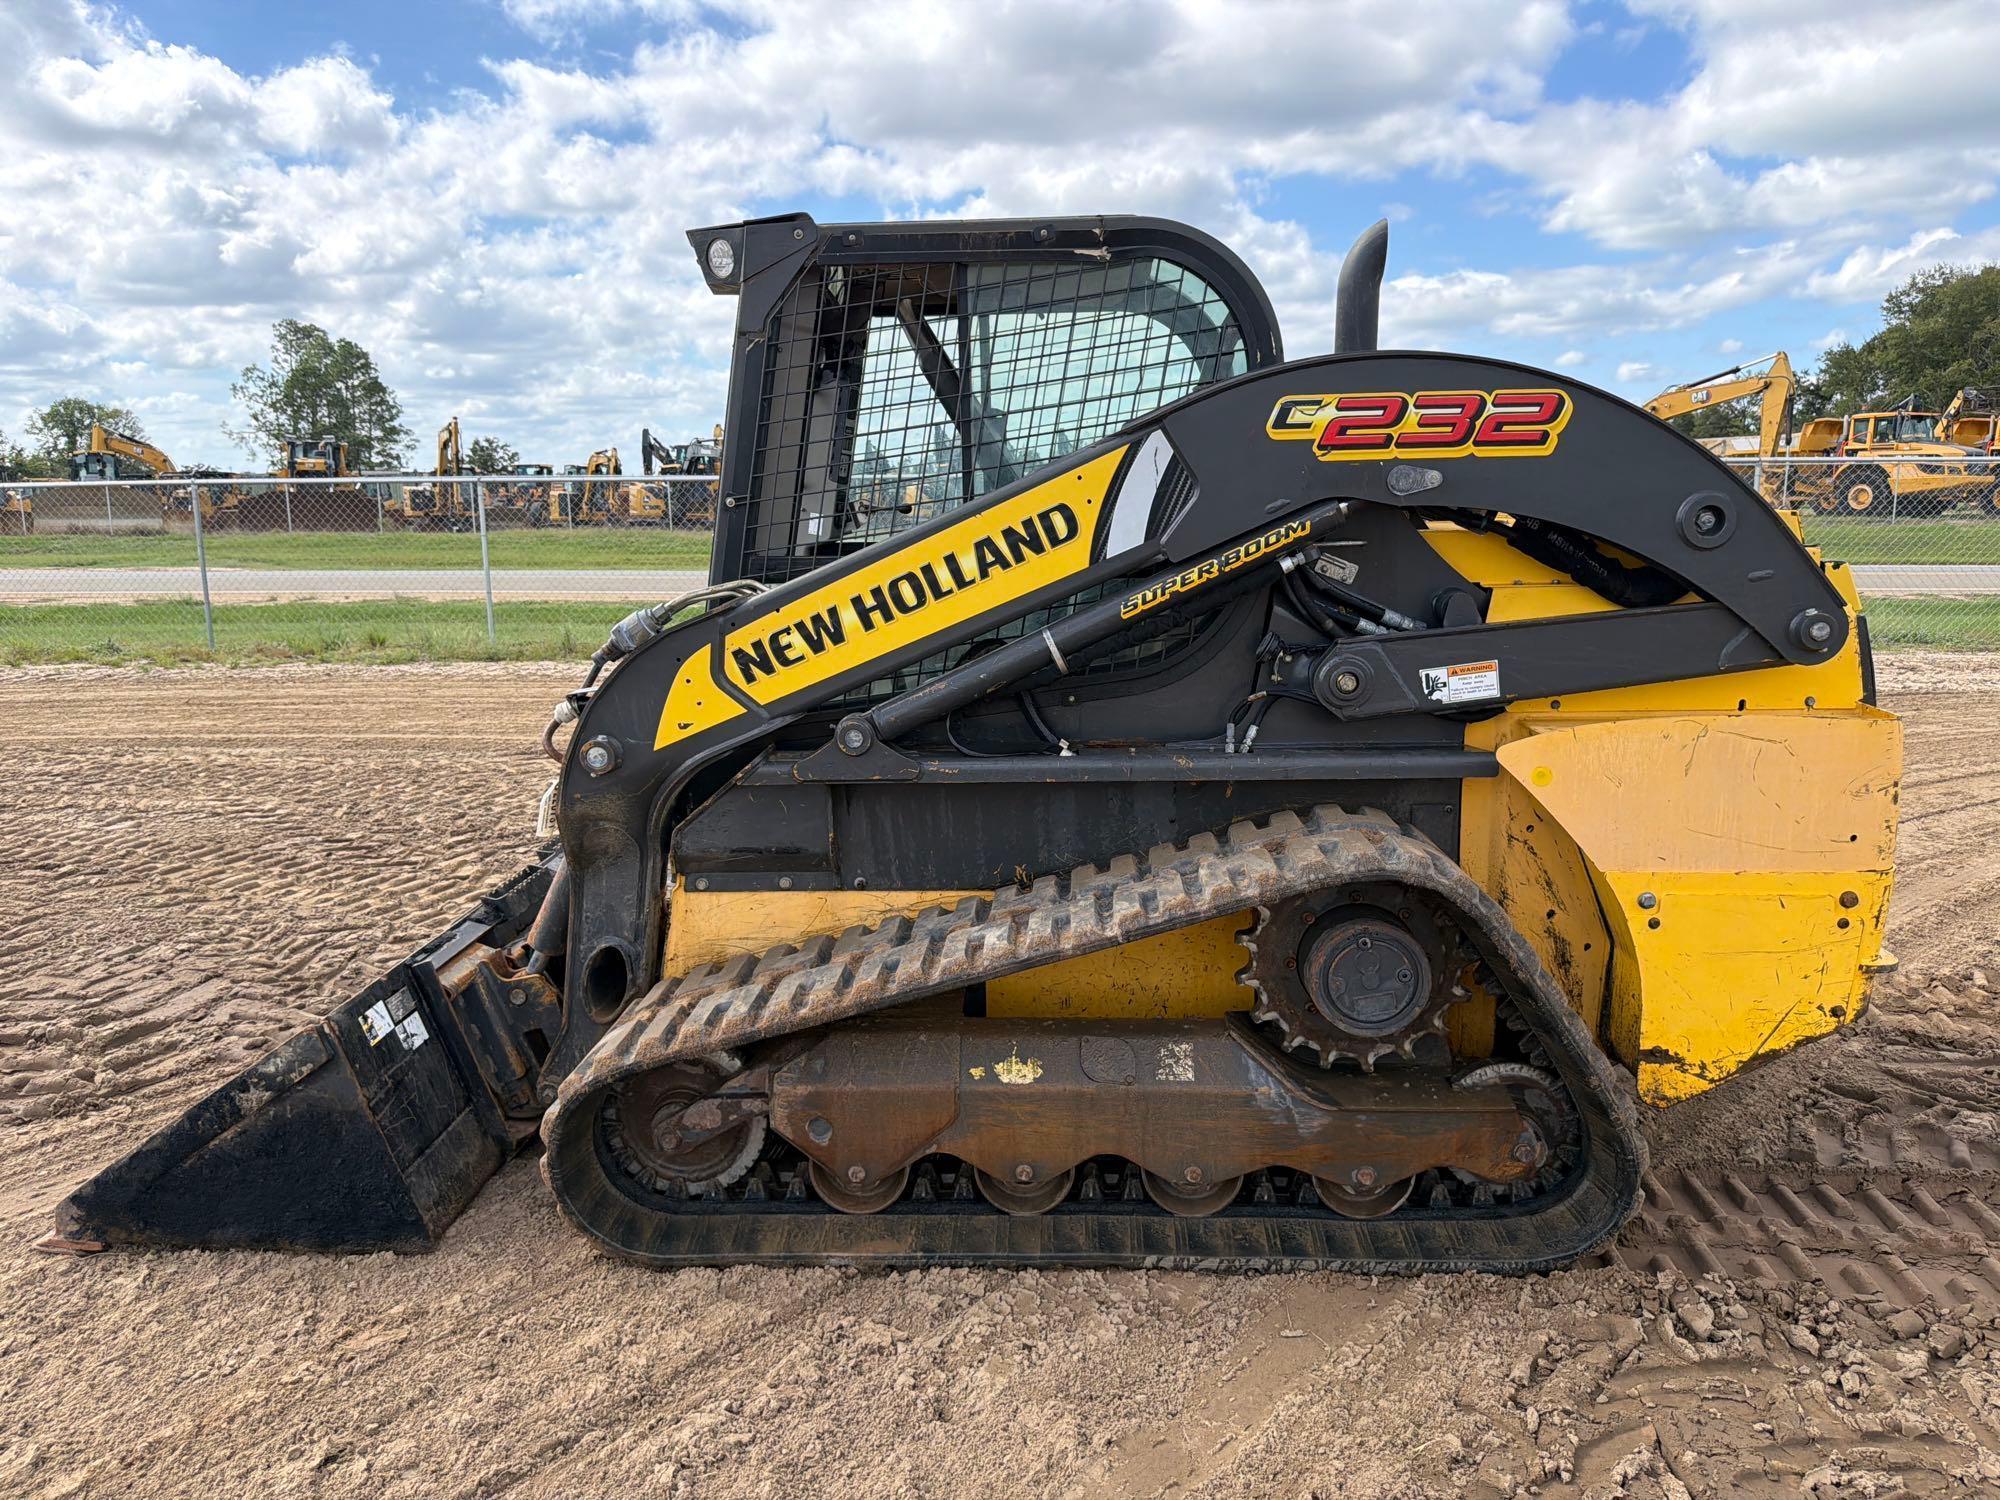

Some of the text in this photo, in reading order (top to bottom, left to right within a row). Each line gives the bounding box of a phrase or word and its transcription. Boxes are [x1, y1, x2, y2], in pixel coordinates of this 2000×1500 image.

[1266, 389, 1574, 461] C232
[1691, 390, 1708, 404] CAT
[731, 502, 1080, 686] NEW HOLLAND
[1121, 559, 1219, 619] SUPER
[1222, 520, 1312, 572] BOOM
[1459, 664, 1493, 673] WARNING
